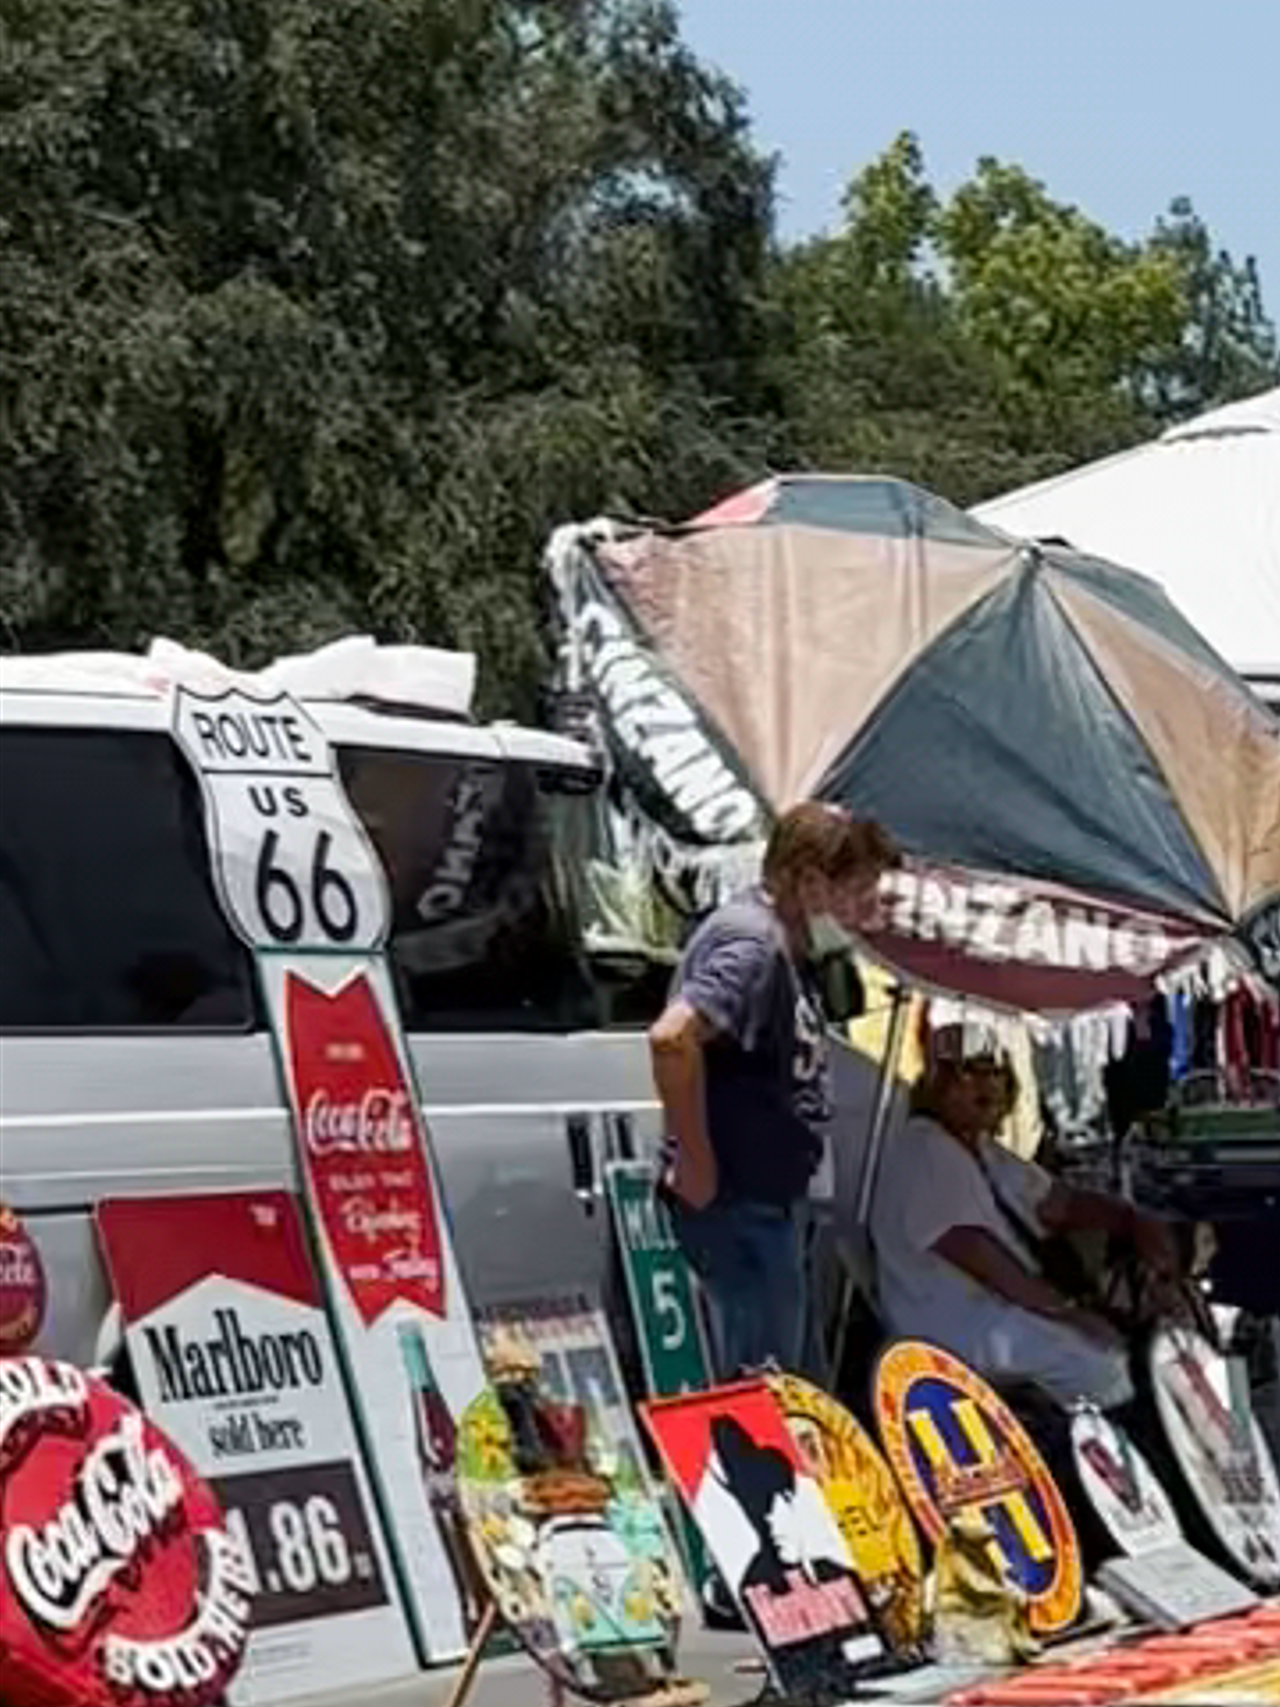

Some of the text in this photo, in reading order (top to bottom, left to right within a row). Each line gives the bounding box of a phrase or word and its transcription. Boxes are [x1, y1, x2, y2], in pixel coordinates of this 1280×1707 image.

[191, 713, 311, 762] ROUTE
[248, 786, 309, 817] US
[256, 830, 358, 943] 66
[652, 1271, 686, 1350] 5
[142, 1308, 324, 1404] Marlboro
[208, 1410, 305, 1459] sold here
